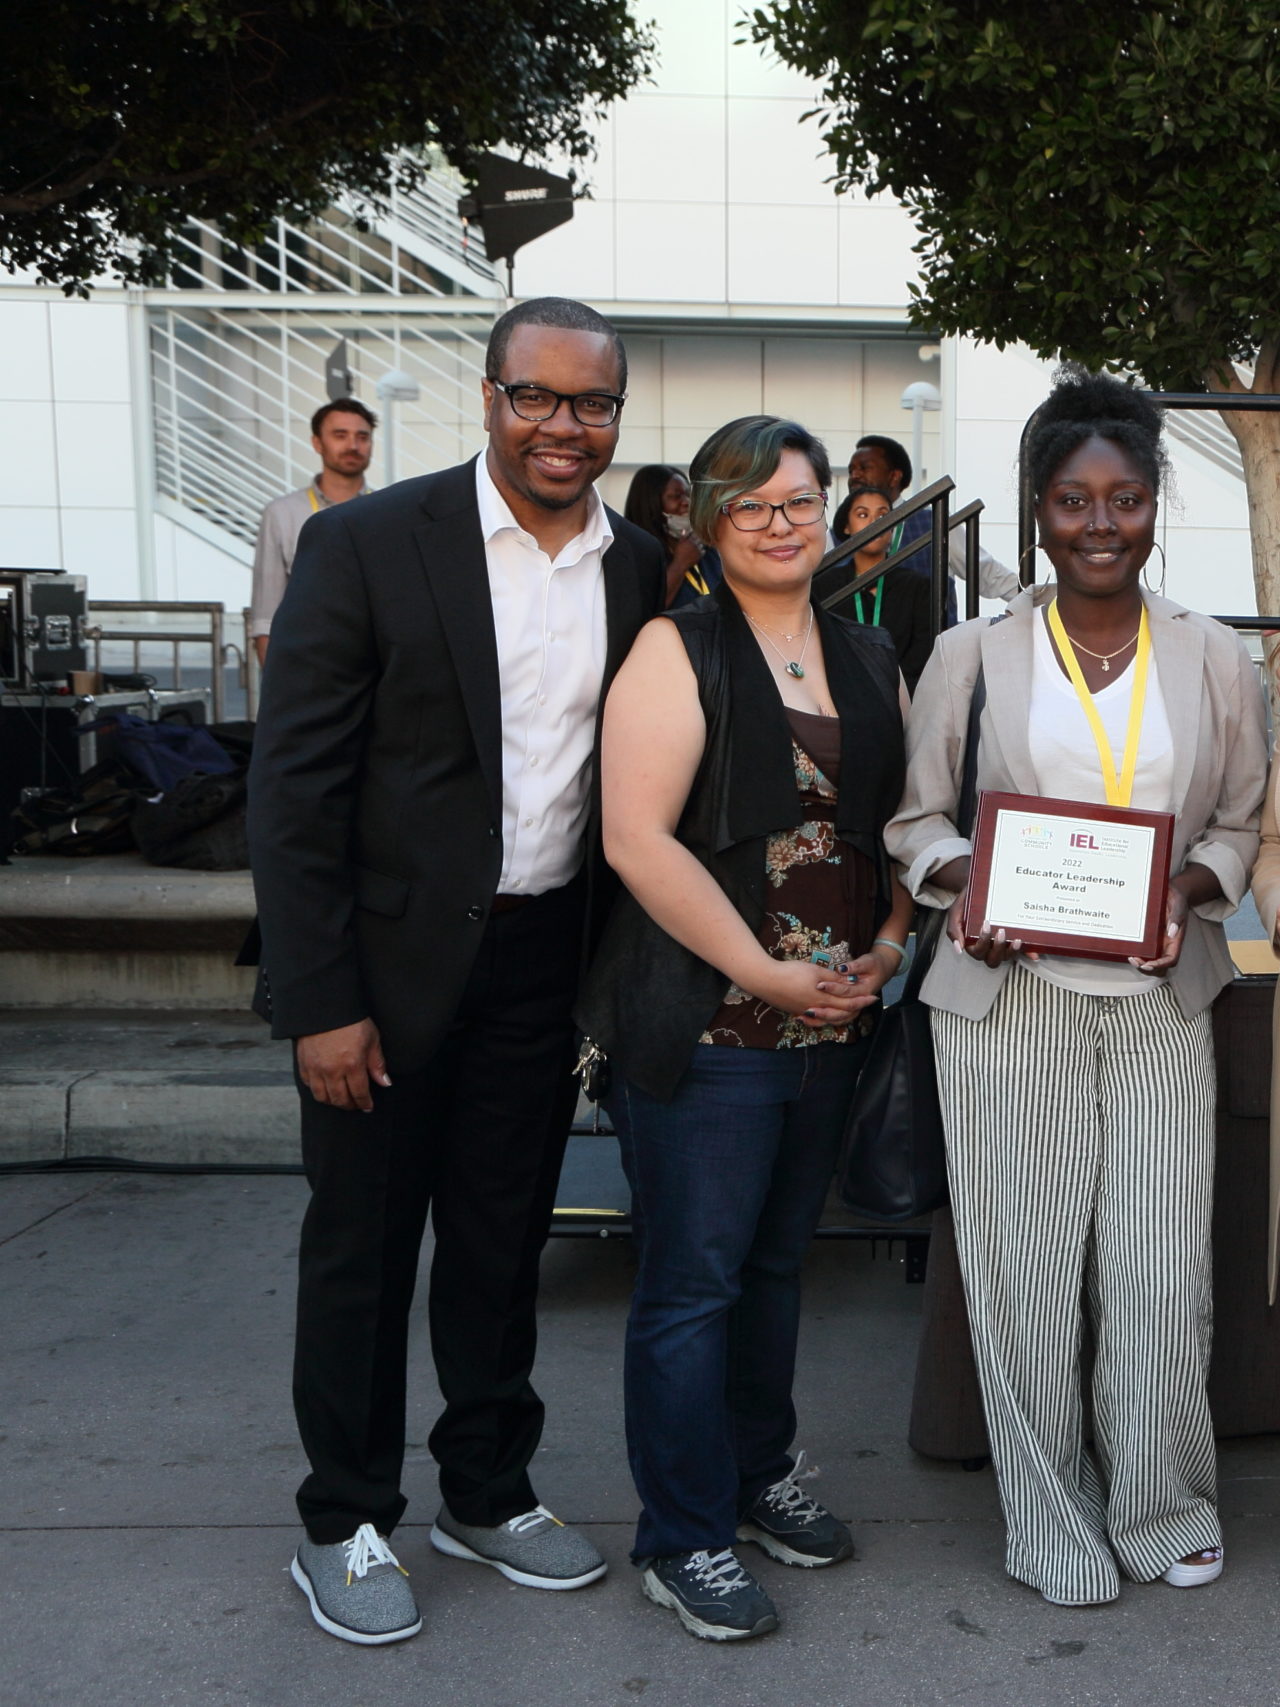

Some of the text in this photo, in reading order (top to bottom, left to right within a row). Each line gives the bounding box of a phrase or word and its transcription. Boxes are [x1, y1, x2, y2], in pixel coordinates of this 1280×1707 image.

[504, 187, 549, 202] SHURE
[1070, 833, 1099, 850] IEL
[1062, 858, 1083, 868] 2022
[1015, 866, 1126, 888] Educator Leadership
[1052, 882, 1087, 893] Award
[1023, 902, 1110, 919] Saisha Brathwaite
